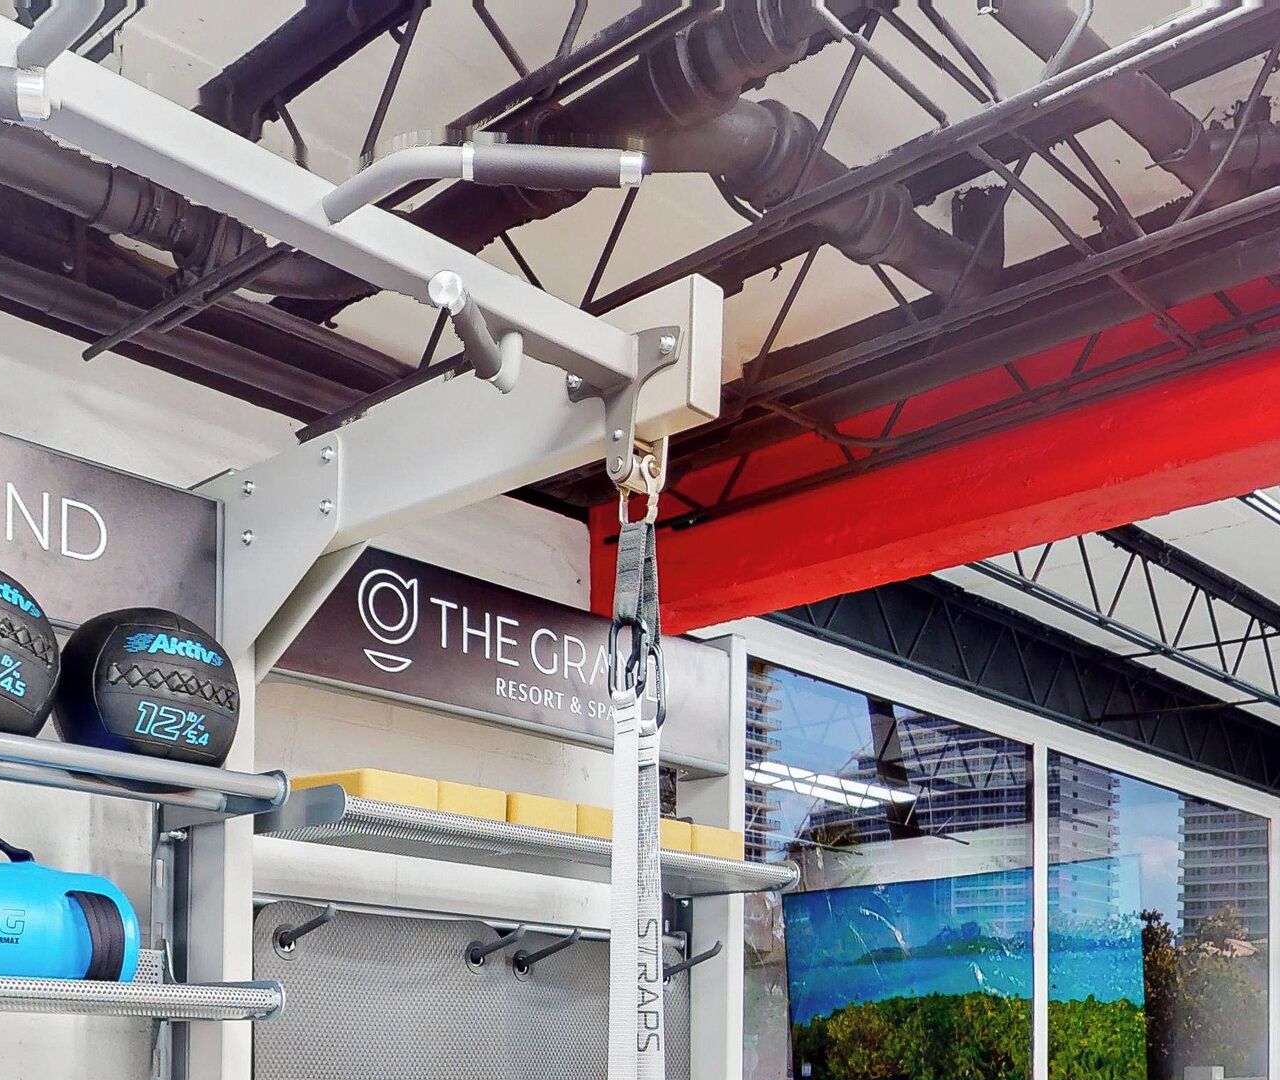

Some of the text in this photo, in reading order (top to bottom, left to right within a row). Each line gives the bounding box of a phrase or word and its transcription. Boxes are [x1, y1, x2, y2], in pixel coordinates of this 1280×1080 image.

[147, 633, 215, 664] Aktiv
[430, 596, 520, 667] THE
[496, 677, 565, 710] RESORT
[570, 696, 583, 716] &
[637, 918, 661, 1053] STRAPS
